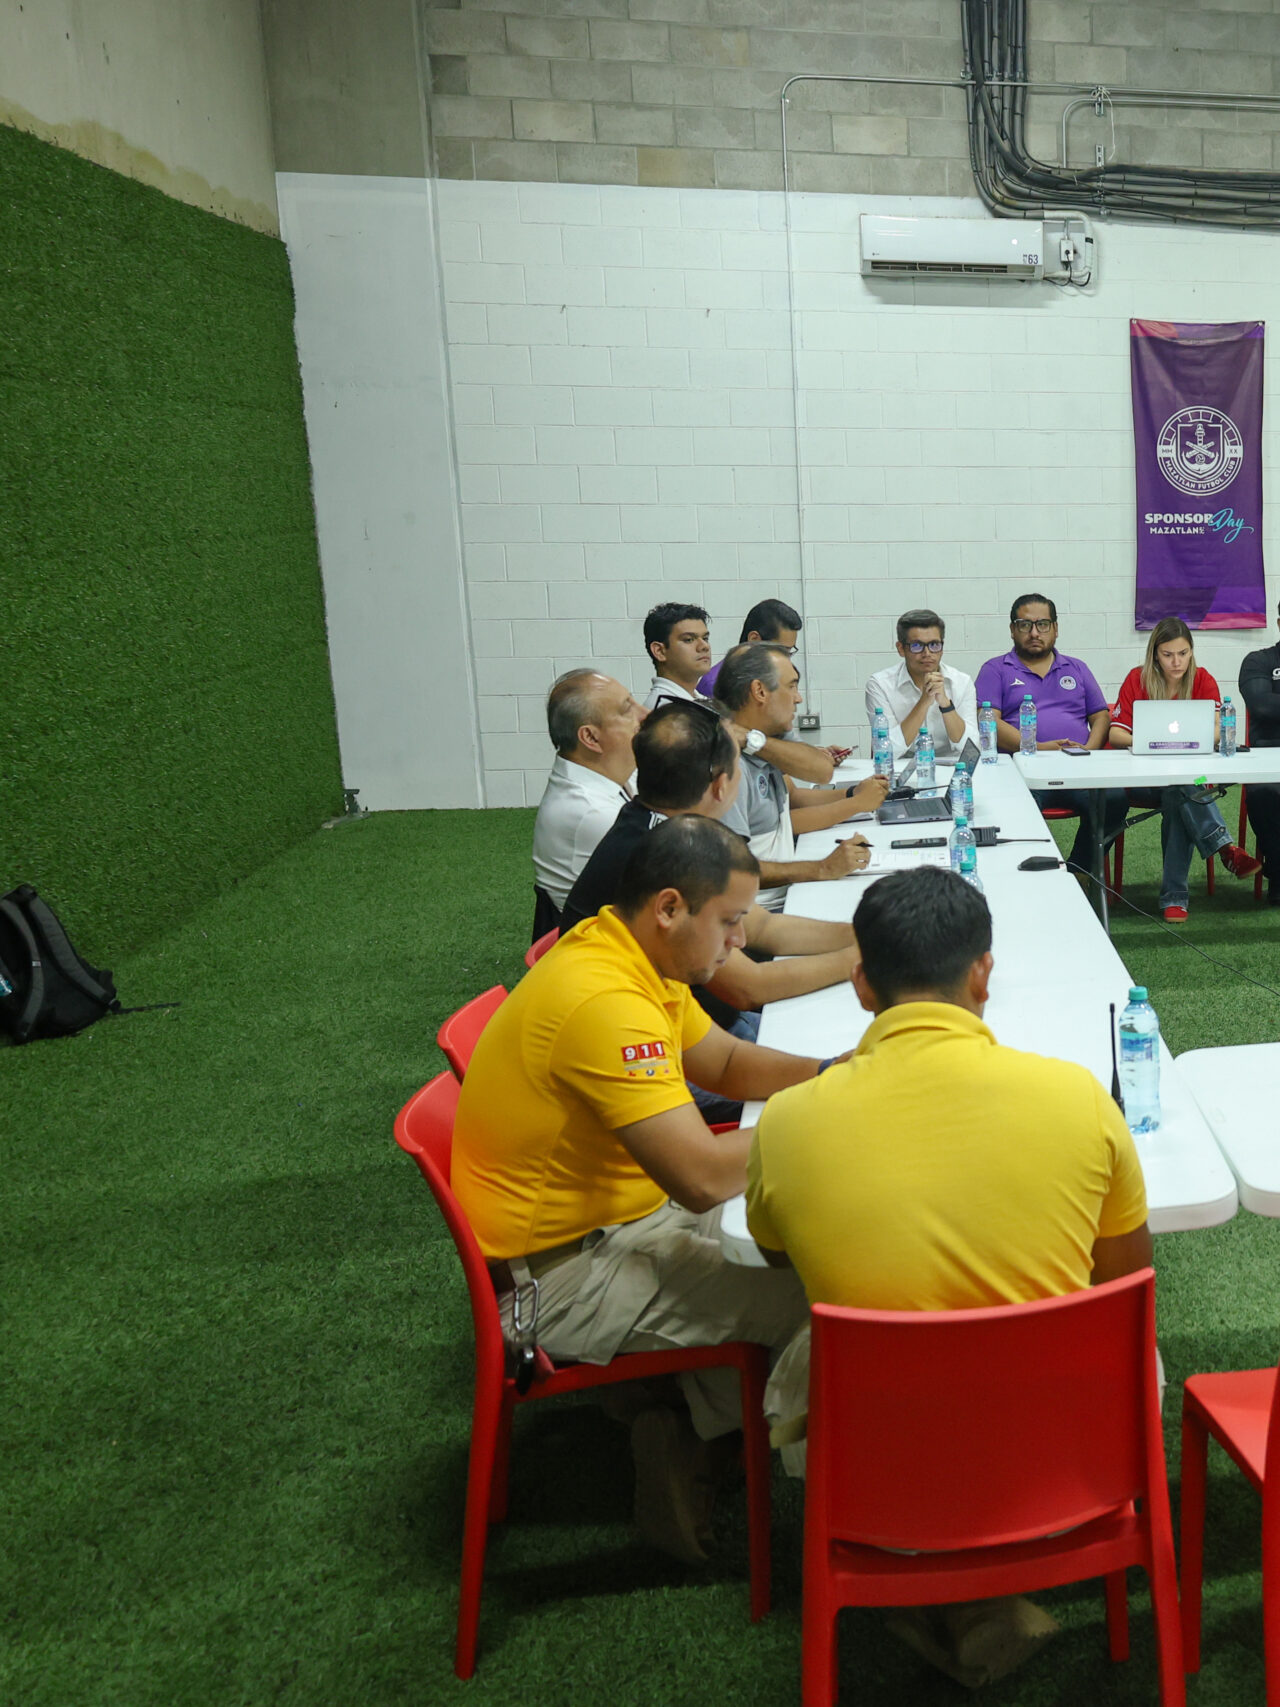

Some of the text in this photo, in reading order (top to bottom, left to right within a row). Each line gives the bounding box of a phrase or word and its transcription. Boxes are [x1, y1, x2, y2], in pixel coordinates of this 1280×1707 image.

[1028, 254, 1038, 264] 63
[1165, 460, 1236, 490] MAZATLAN FUTBOL CLUB
[1144, 508, 1254, 543] SPONSOR Day
[624, 1042, 664, 1060] 911
